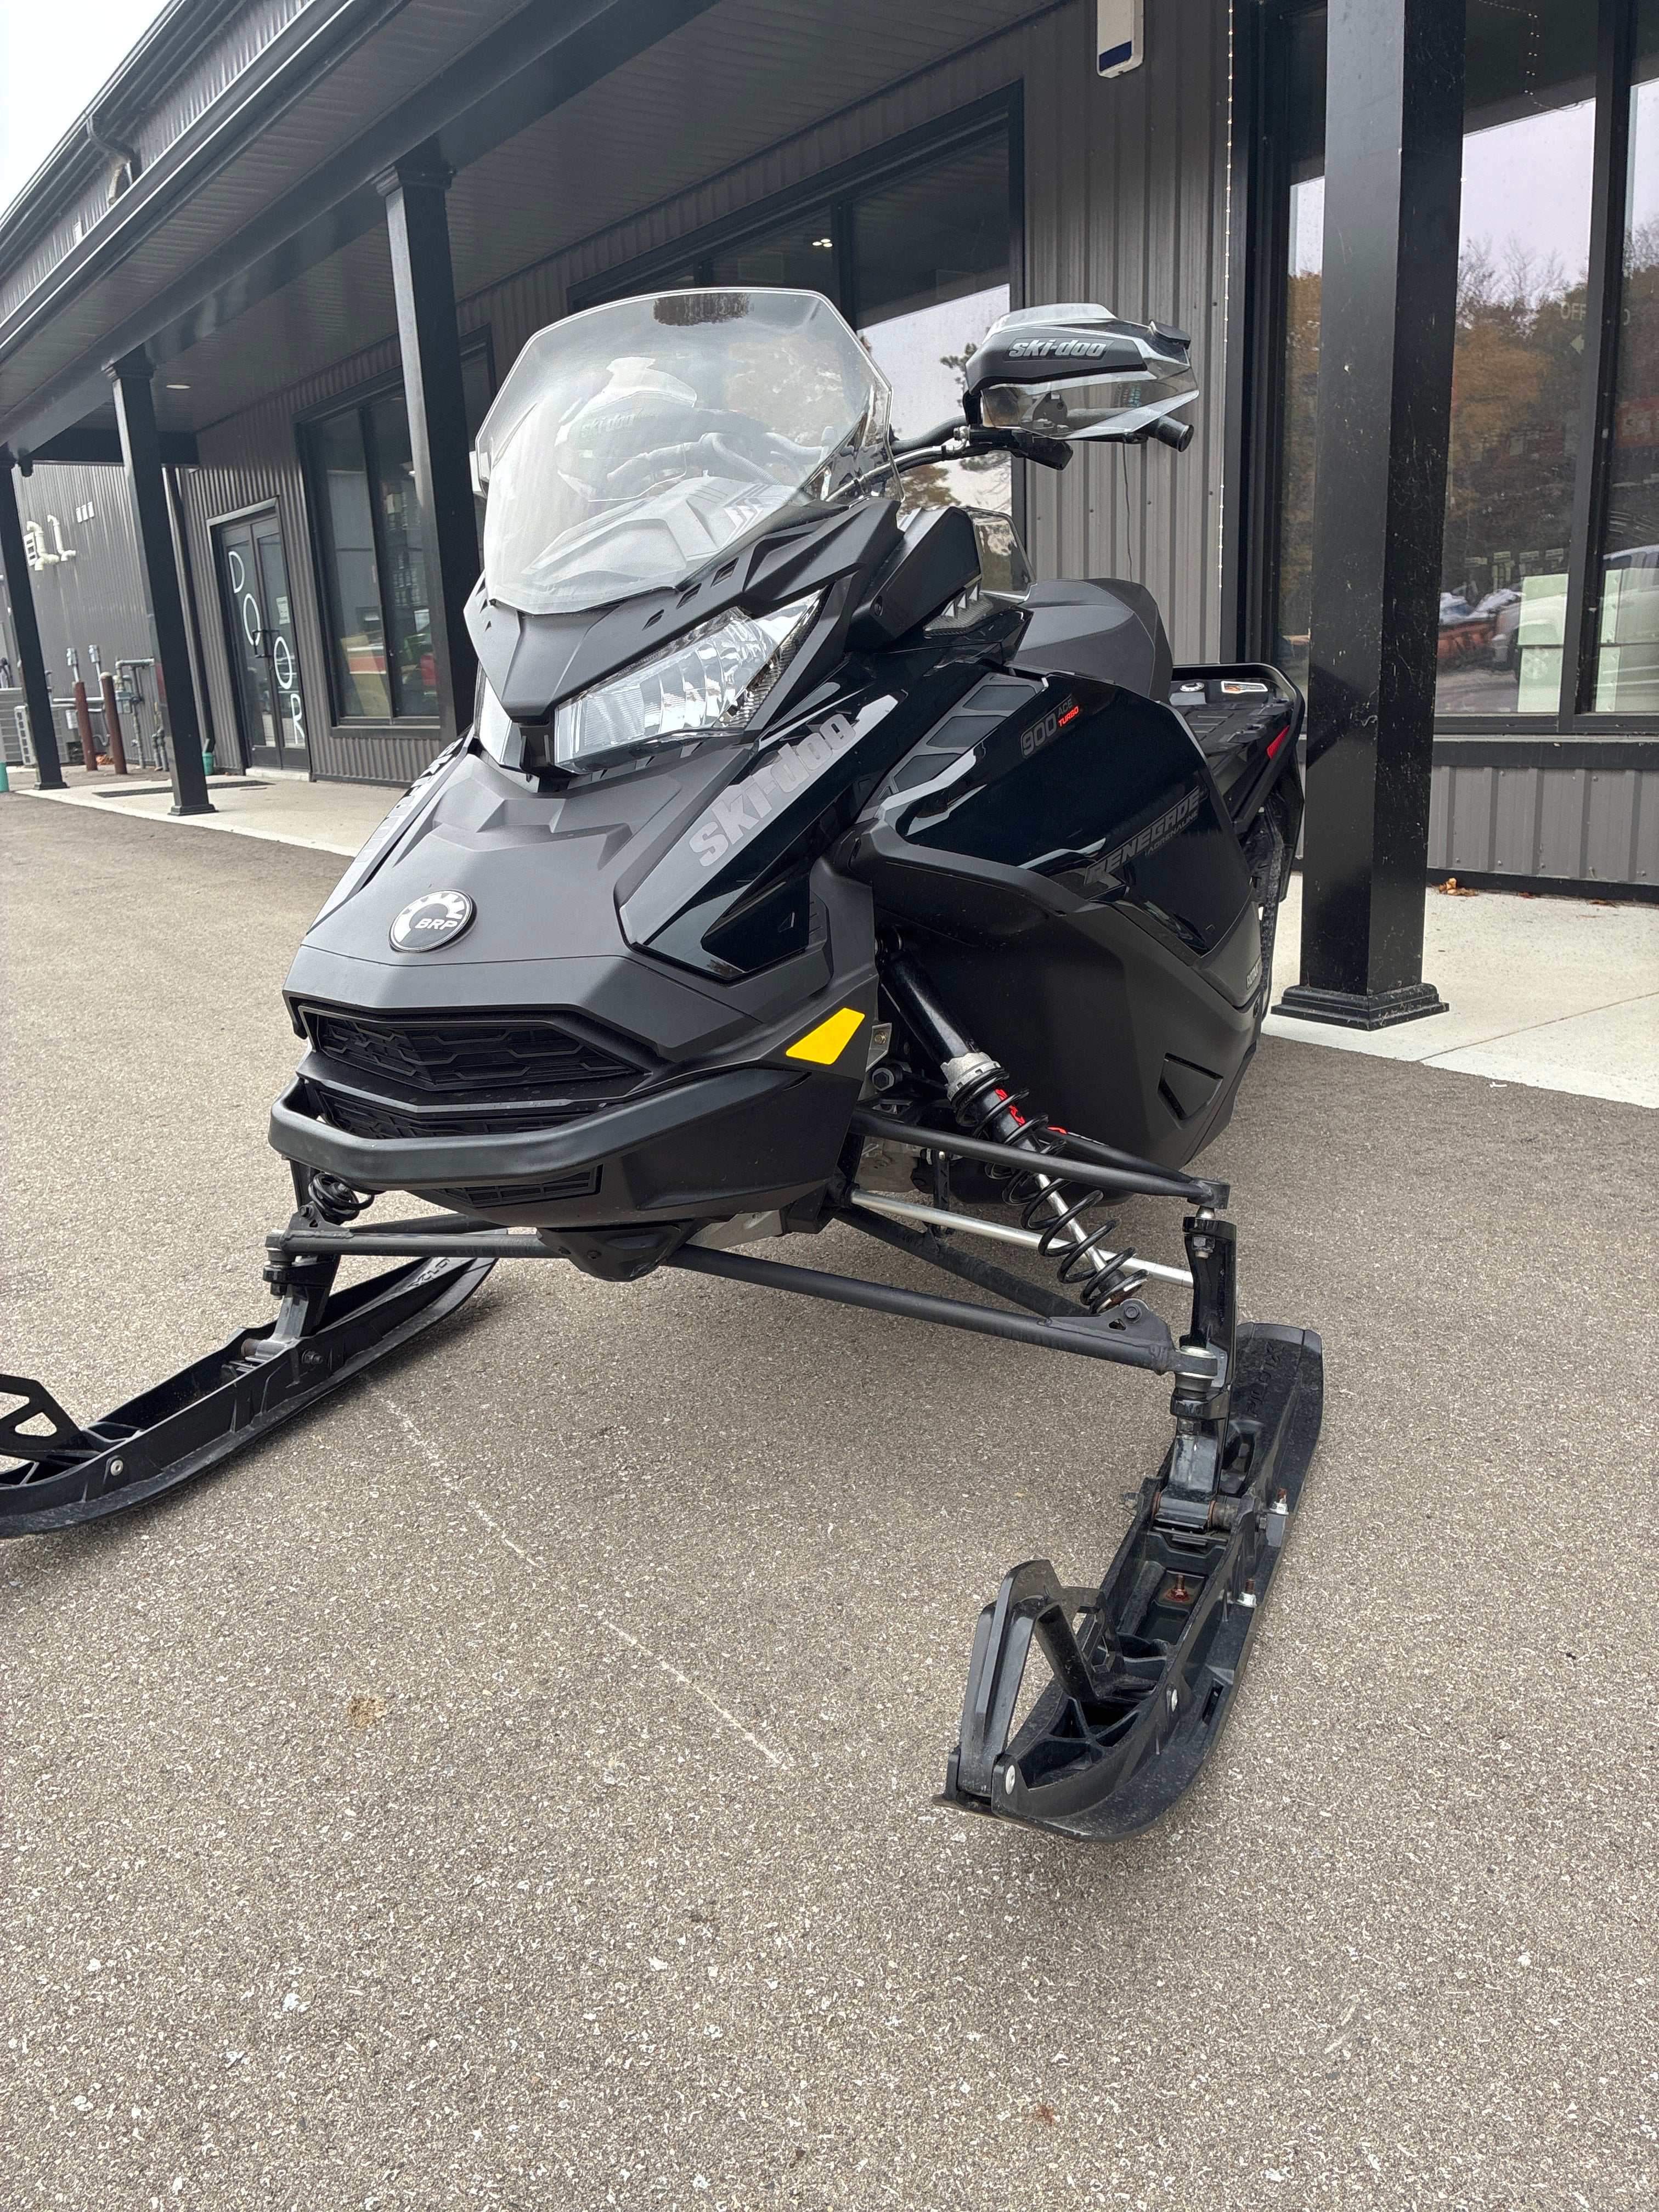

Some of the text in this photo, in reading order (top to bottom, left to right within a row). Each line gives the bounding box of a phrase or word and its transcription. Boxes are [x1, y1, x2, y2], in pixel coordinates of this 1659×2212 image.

[1058, 706, 1080, 727] TURBO
[1022, 713, 1057, 756] 900
[1086, 788, 1199, 885] RENEGADE
[414, 918, 458, 930] BRP
